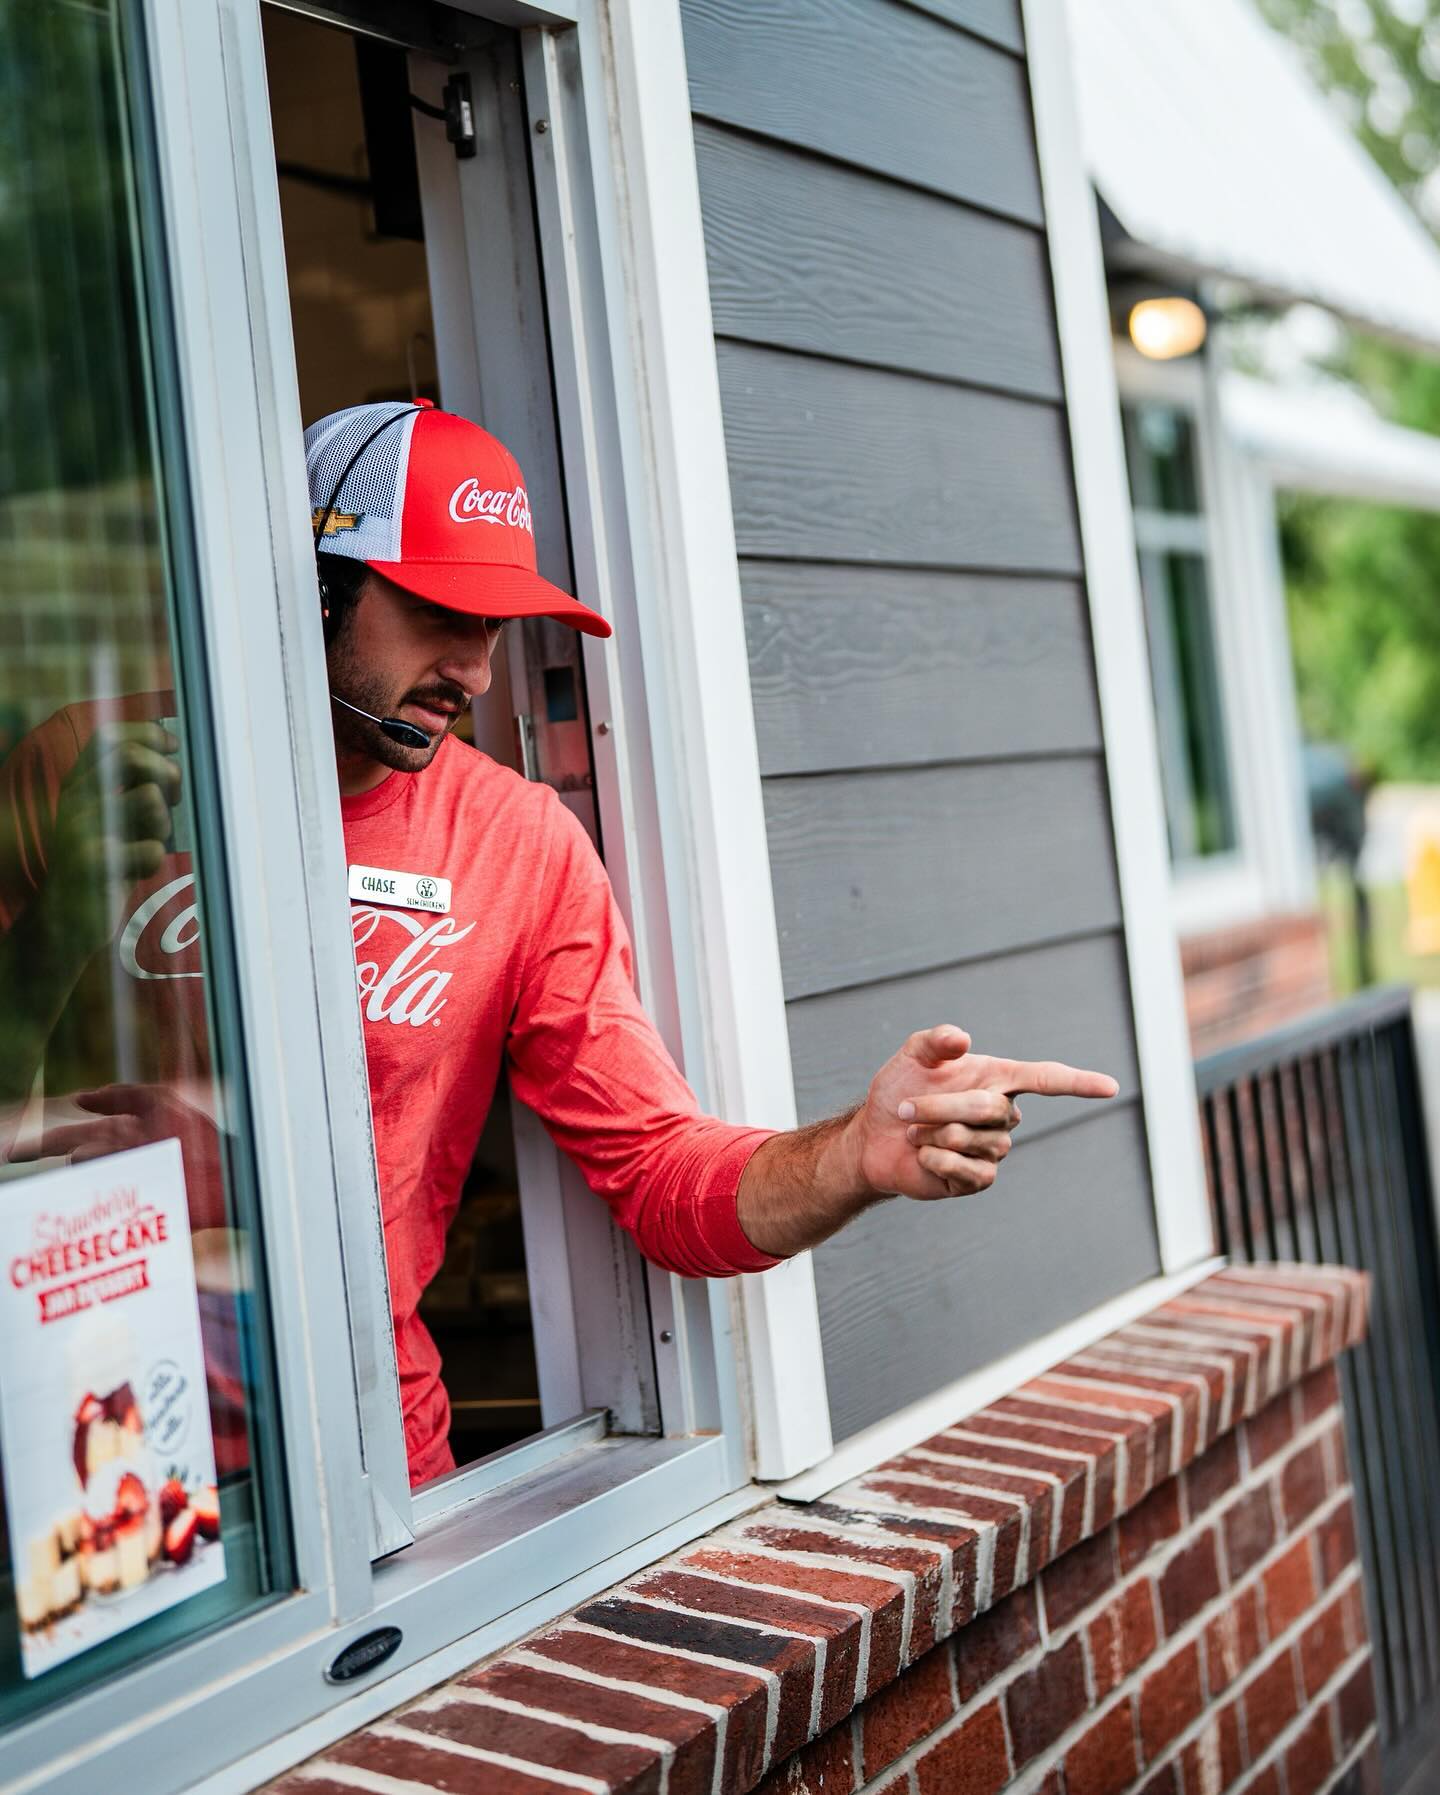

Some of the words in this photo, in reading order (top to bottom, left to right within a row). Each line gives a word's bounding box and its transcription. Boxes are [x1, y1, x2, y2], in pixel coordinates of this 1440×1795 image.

[361, 876, 396, 894] CHASE
[406, 897, 419, 906] SLIM
[420, 899, 446, 910] CHICKENS
[10, 1213, 168, 1290] CHEESECAKE
